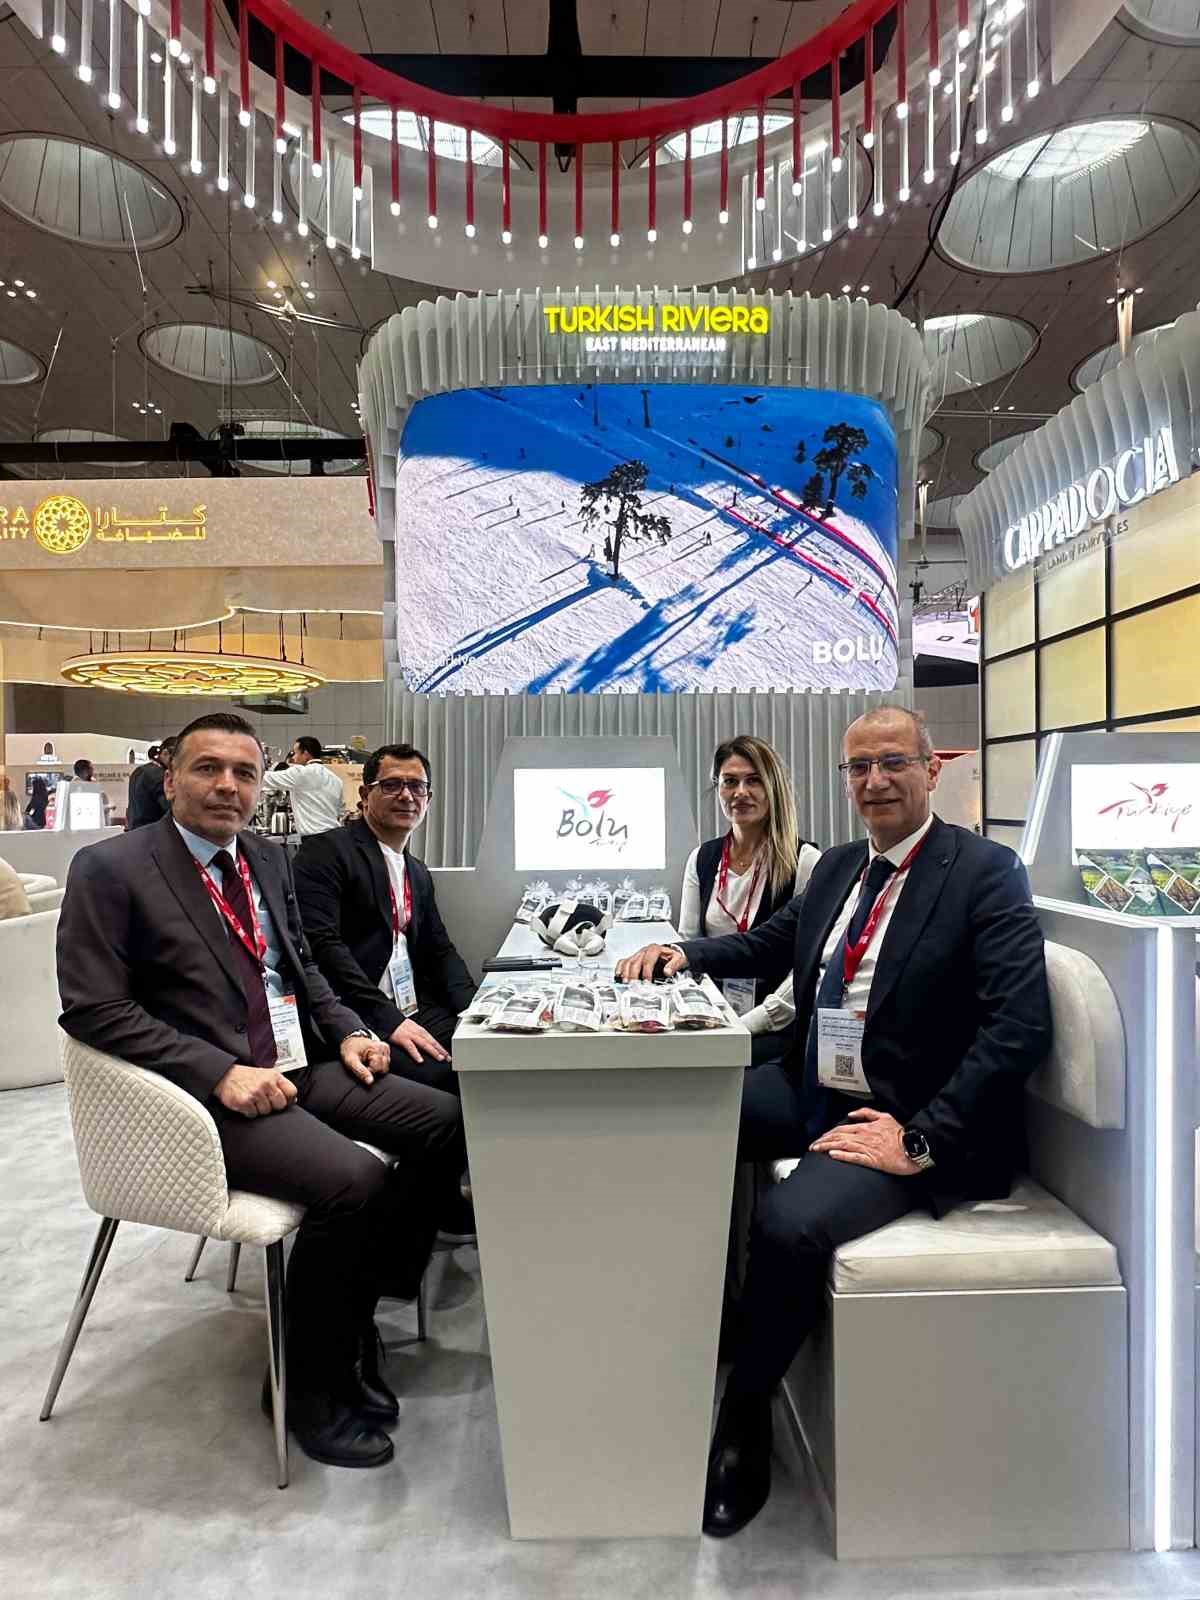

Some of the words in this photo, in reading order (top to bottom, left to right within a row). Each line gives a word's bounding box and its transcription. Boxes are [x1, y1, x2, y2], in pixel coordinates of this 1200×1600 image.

[543, 304, 654, 334] TURKISH
[586, 336, 618, 352] EAST
[620, 336, 727, 352] MEDITERRANEAN
[1003, 427, 1180, 570] CAPPADOCIA
[0, 527, 31, 540] ITY
[812, 633, 885, 664] BOLU
